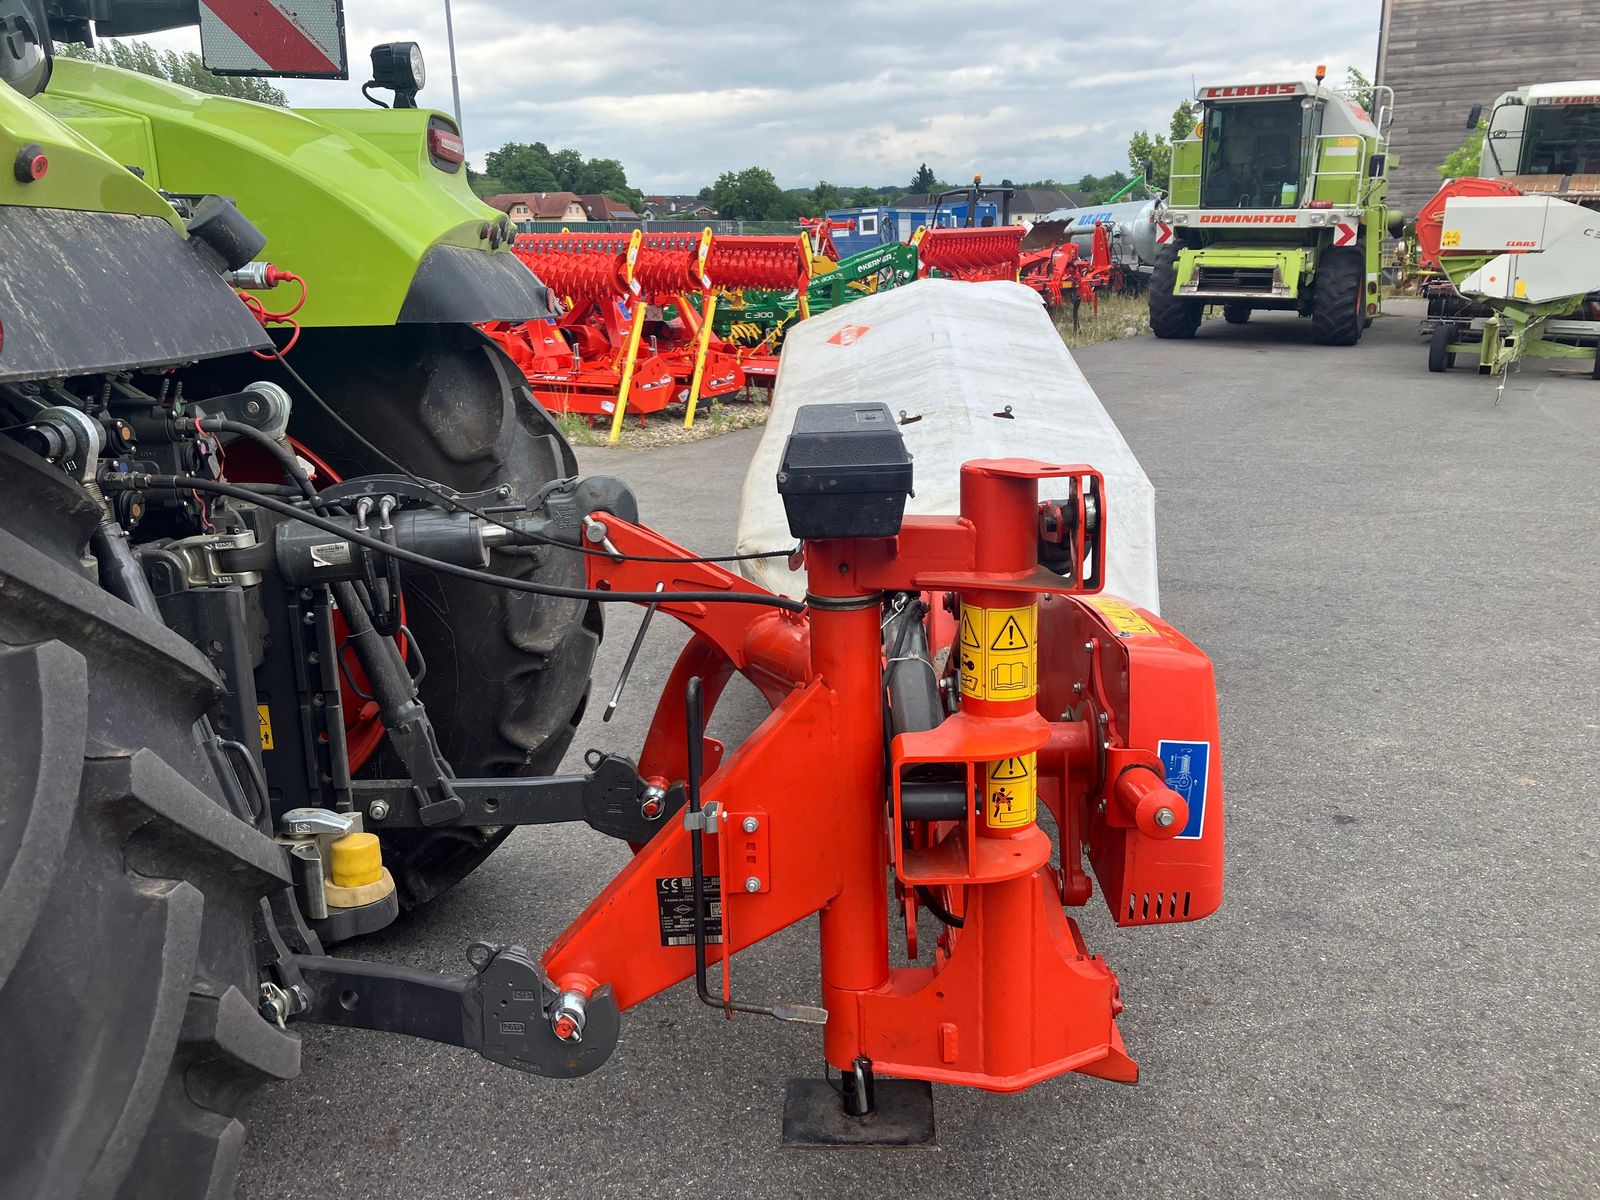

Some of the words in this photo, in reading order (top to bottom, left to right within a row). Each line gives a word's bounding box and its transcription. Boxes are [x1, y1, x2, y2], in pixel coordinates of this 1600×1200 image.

[1207, 84, 1297, 98] CLAAS
[1200, 215, 1297, 223] DOMINATOR
[862, 253, 893, 271] KERNER
[661, 878, 679, 889] CE
